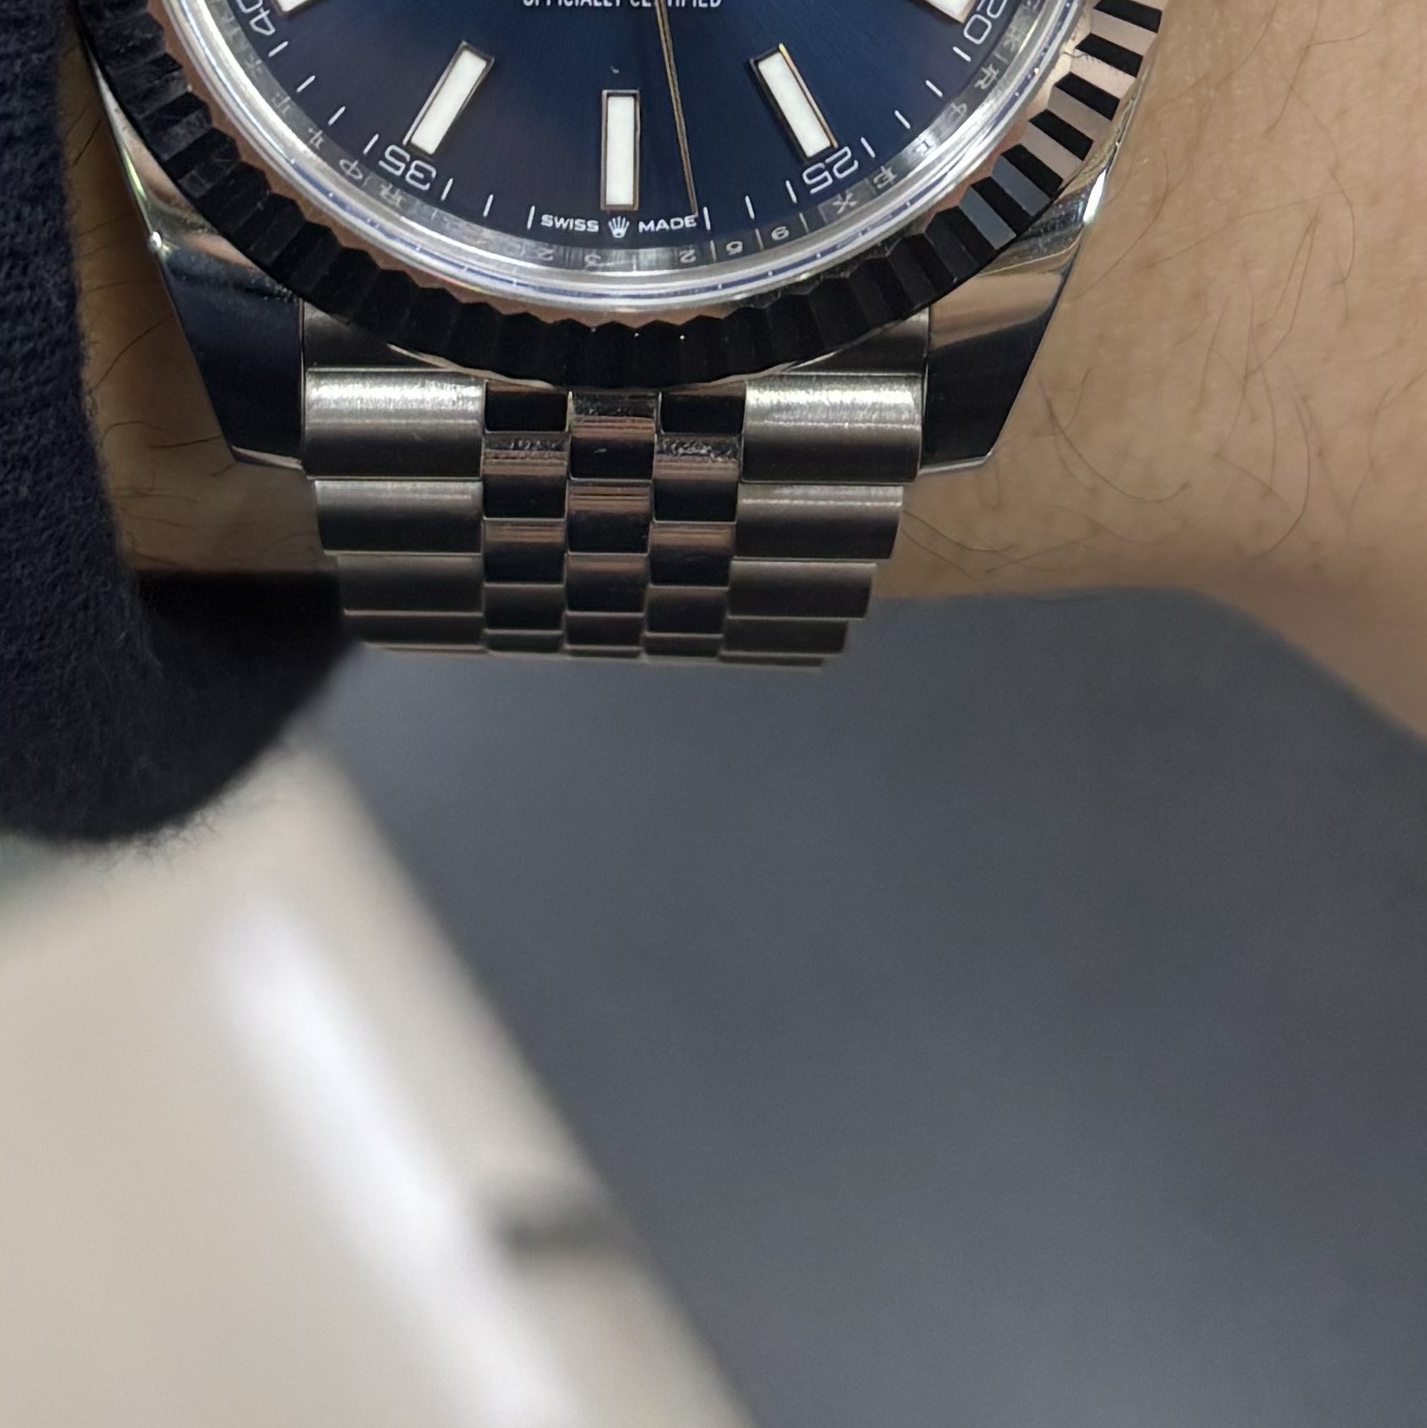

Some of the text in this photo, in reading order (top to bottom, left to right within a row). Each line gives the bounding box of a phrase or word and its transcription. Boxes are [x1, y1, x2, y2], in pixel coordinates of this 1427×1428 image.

[378, 143, 438, 192] 35
[802, 146, 859, 194] 25
[540, 214, 698, 233] SWISS MADE
